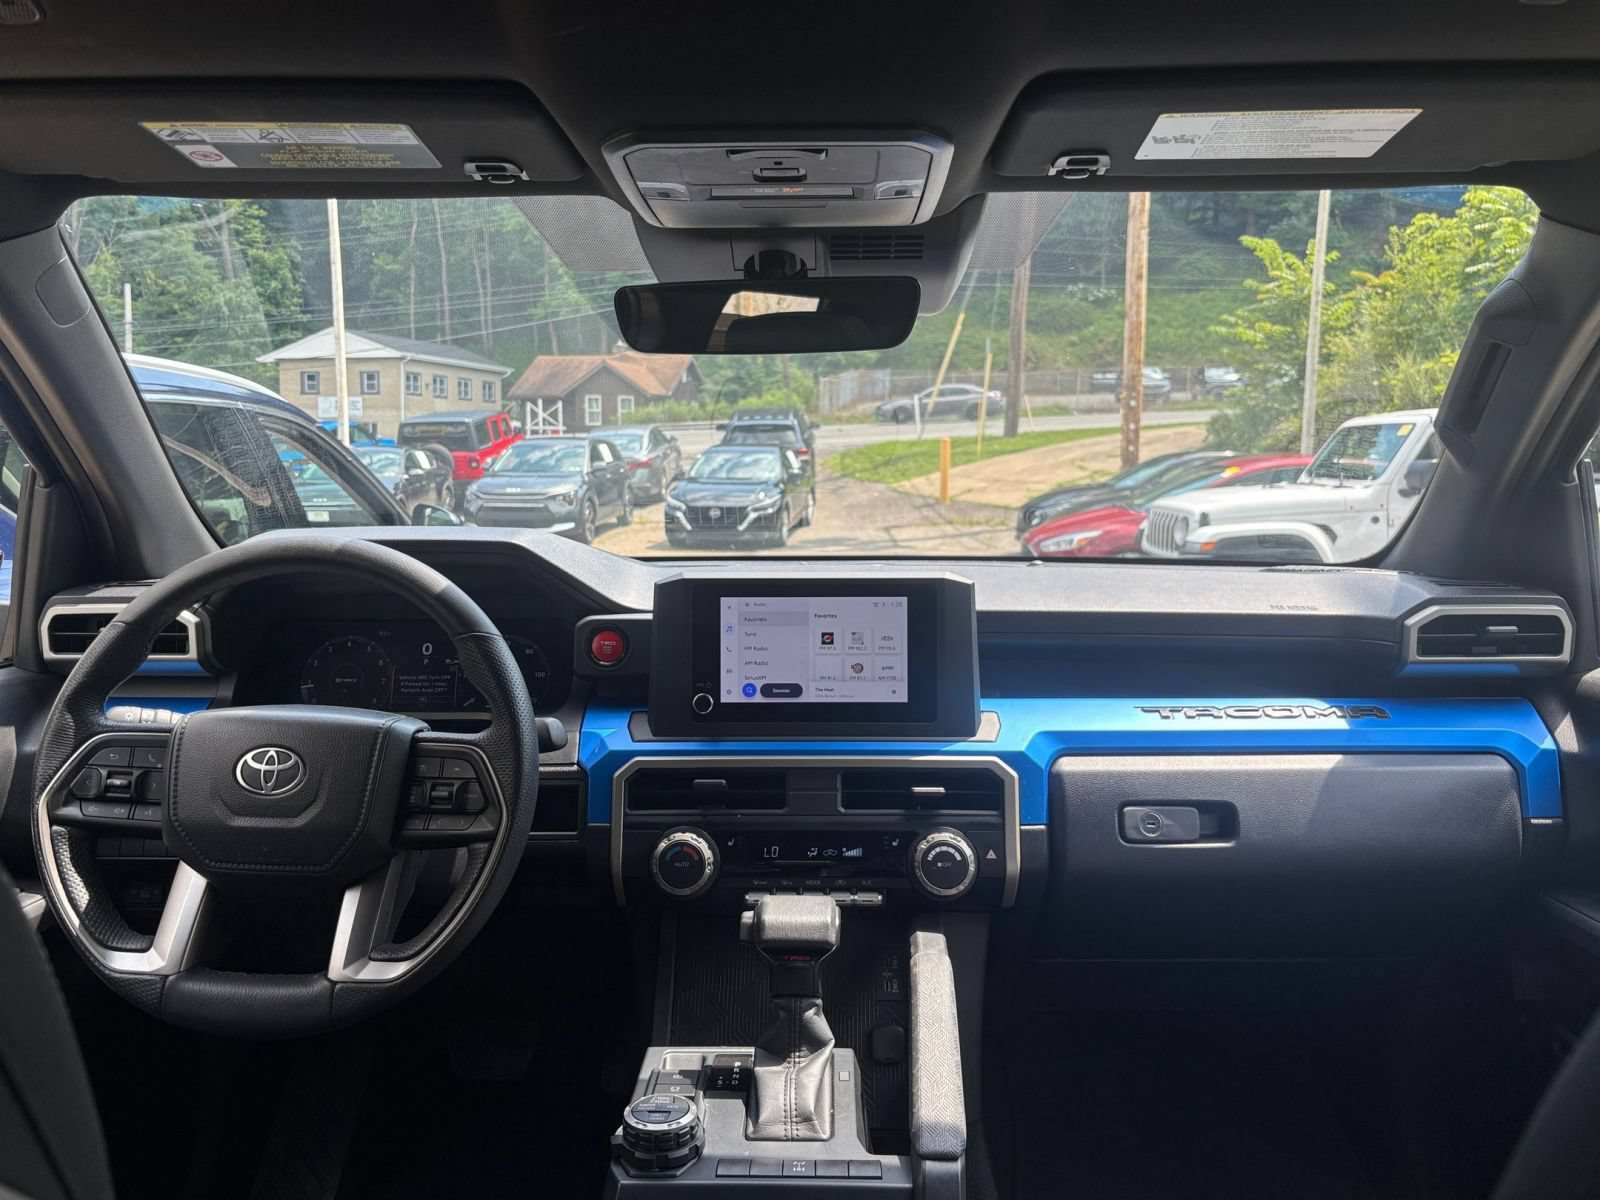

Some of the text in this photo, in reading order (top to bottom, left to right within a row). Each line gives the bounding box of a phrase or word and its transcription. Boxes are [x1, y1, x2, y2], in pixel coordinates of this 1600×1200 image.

[422, 642, 433, 656] 0
[423, 658, 429, 666] P
[1134, 704, 1392, 720] TACOMA
